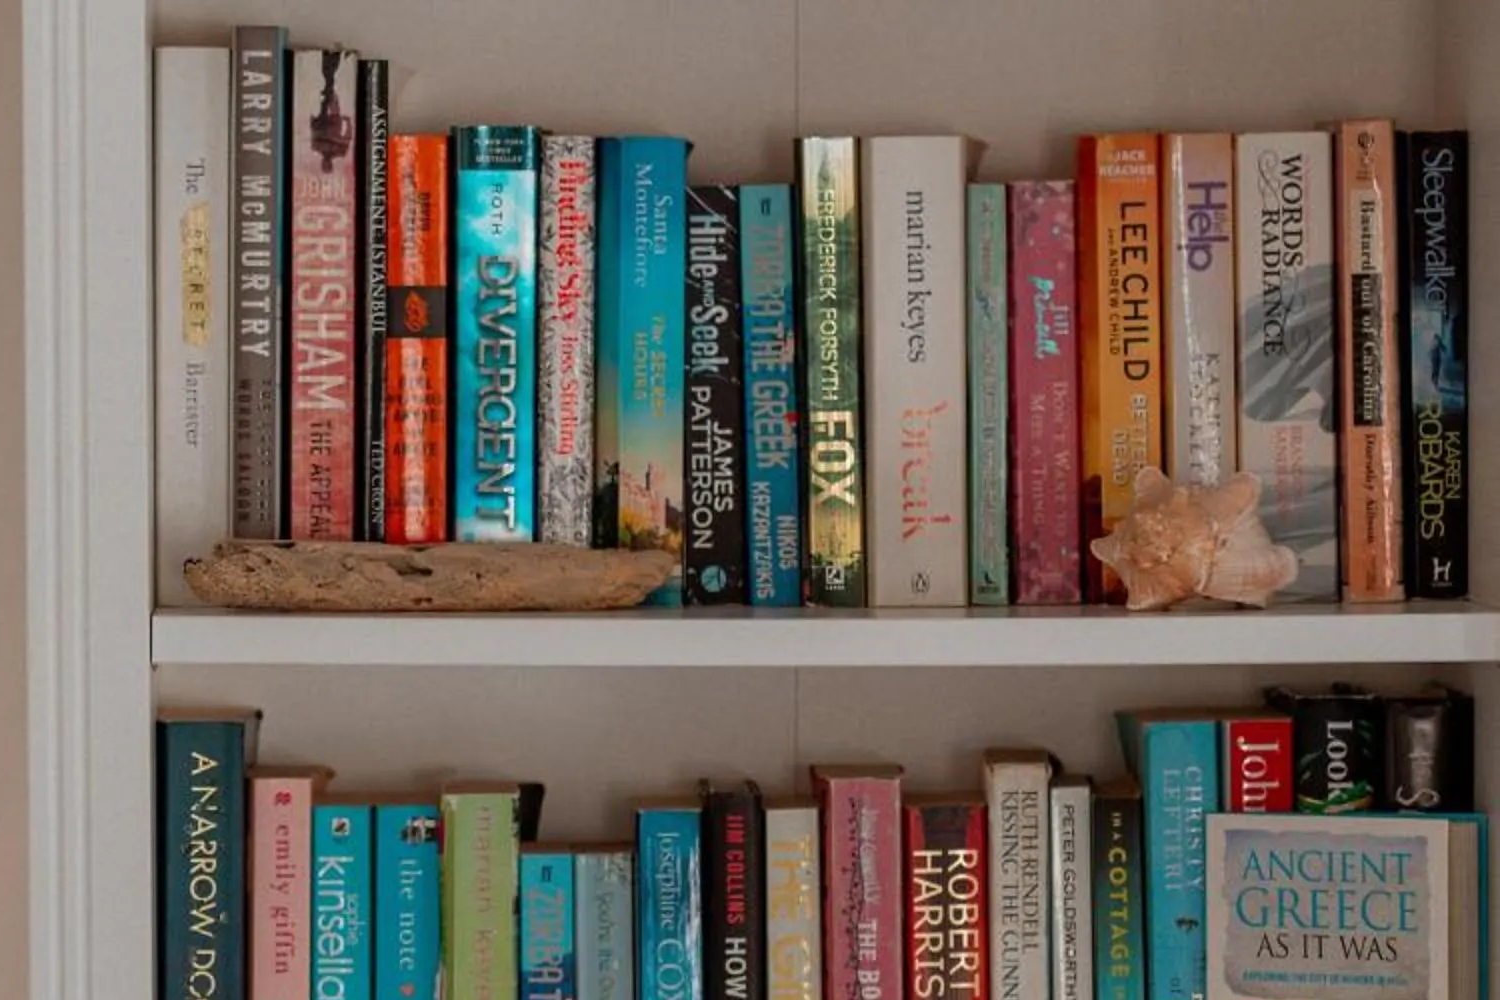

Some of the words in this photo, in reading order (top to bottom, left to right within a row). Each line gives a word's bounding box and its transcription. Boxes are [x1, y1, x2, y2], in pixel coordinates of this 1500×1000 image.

[241, 50, 272, 156] LARRY
[185, 158, 206, 196] The
[1099, 164, 1155, 176] REACHER
[1113, 150, 1146, 160] JACK
[490, 182, 504, 237] ROTH
[555, 160, 589, 268] Finding
[634, 163, 654, 288] Montefiore
[653, 194, 674, 255] Santa
[689, 214, 727, 279] Hide
[819, 189, 837, 301] FREDERICK
[905, 191, 931, 284] marian
[1120, 202, 1148, 265] LEE
[1177, 181, 1230, 272] Help
[1280, 154, 1304, 268] WORDS
[1360, 201, 1377, 271] Bastard
[1415, 148, 1456, 313] Sleepwalker
[370, 244, 387, 337] ISTANBUL
[549, 272, 583, 324] Sky
[748, 224, 787, 317] ZORBA
[1108, 249, 1119, 307] ANDREW
[1260, 209, 1284, 357] RADIANCE
[1361, 278, 1376, 308] out
[296, 206, 349, 413] GRISHAM
[690, 305, 729, 374] Seek
[901, 290, 932, 363] keyes
[1108, 313, 1119, 356] CHILD
[1122, 274, 1150, 381] CHILD
[1361, 315, 1377, 335] of
[749, 322, 787, 372] THE
[819, 307, 839, 400] FORSYTH
[1362, 342, 1379, 421] Carolina
[476, 255, 518, 530] DIVERGENT
[751, 380, 789, 470] GREEK
[309, 420, 332, 455] THE
[691, 386, 713, 548] PATTERSON
[713, 421, 733, 512] JAMES
[810, 411, 855, 506] FOX
[1417, 402, 1445, 540] ROBARDS
[1444, 432, 1461, 499] KAREN
[309, 463, 332, 540] APPEAL
[752, 481, 775, 599] KAZANTZAKIS
[776, 516, 798, 570] NIKOS
[191, 752, 219, 775] A
[725, 815, 744, 843] JIM
[1001, 790, 1019, 874] KISSING
[1021, 790, 1039, 850] RUTH
[1062, 804, 1076, 862] PETER
[189, 786, 218, 937] NARROW
[271, 824, 296, 894] emily
[398, 859, 423, 900] the
[656, 832, 682, 930] Josephine
[725, 850, 745, 925] COLLINS
[771, 834, 815, 919] THE
[1242, 849, 1412, 884] ANCIENT
[528, 888, 565, 983] ZORBA
[913, 849, 945, 998] HARRIS
[947, 849, 980, 997] ROBERT
[1002, 879, 1019, 922] THE
[1021, 858, 1039, 954] RENDELL
[1108, 847, 1130, 977] COTTAGE
[1236, 887, 1419, 932] GREECE
[271, 906, 296, 974] giffin
[398, 912, 417, 971] note
[724, 936, 747, 999] HOW
[858, 918, 877, 961] THE
[1256, 933, 1289, 959] AS
[1302, 935, 1330, 959] IT
[1339, 936, 1398, 961] WAS
